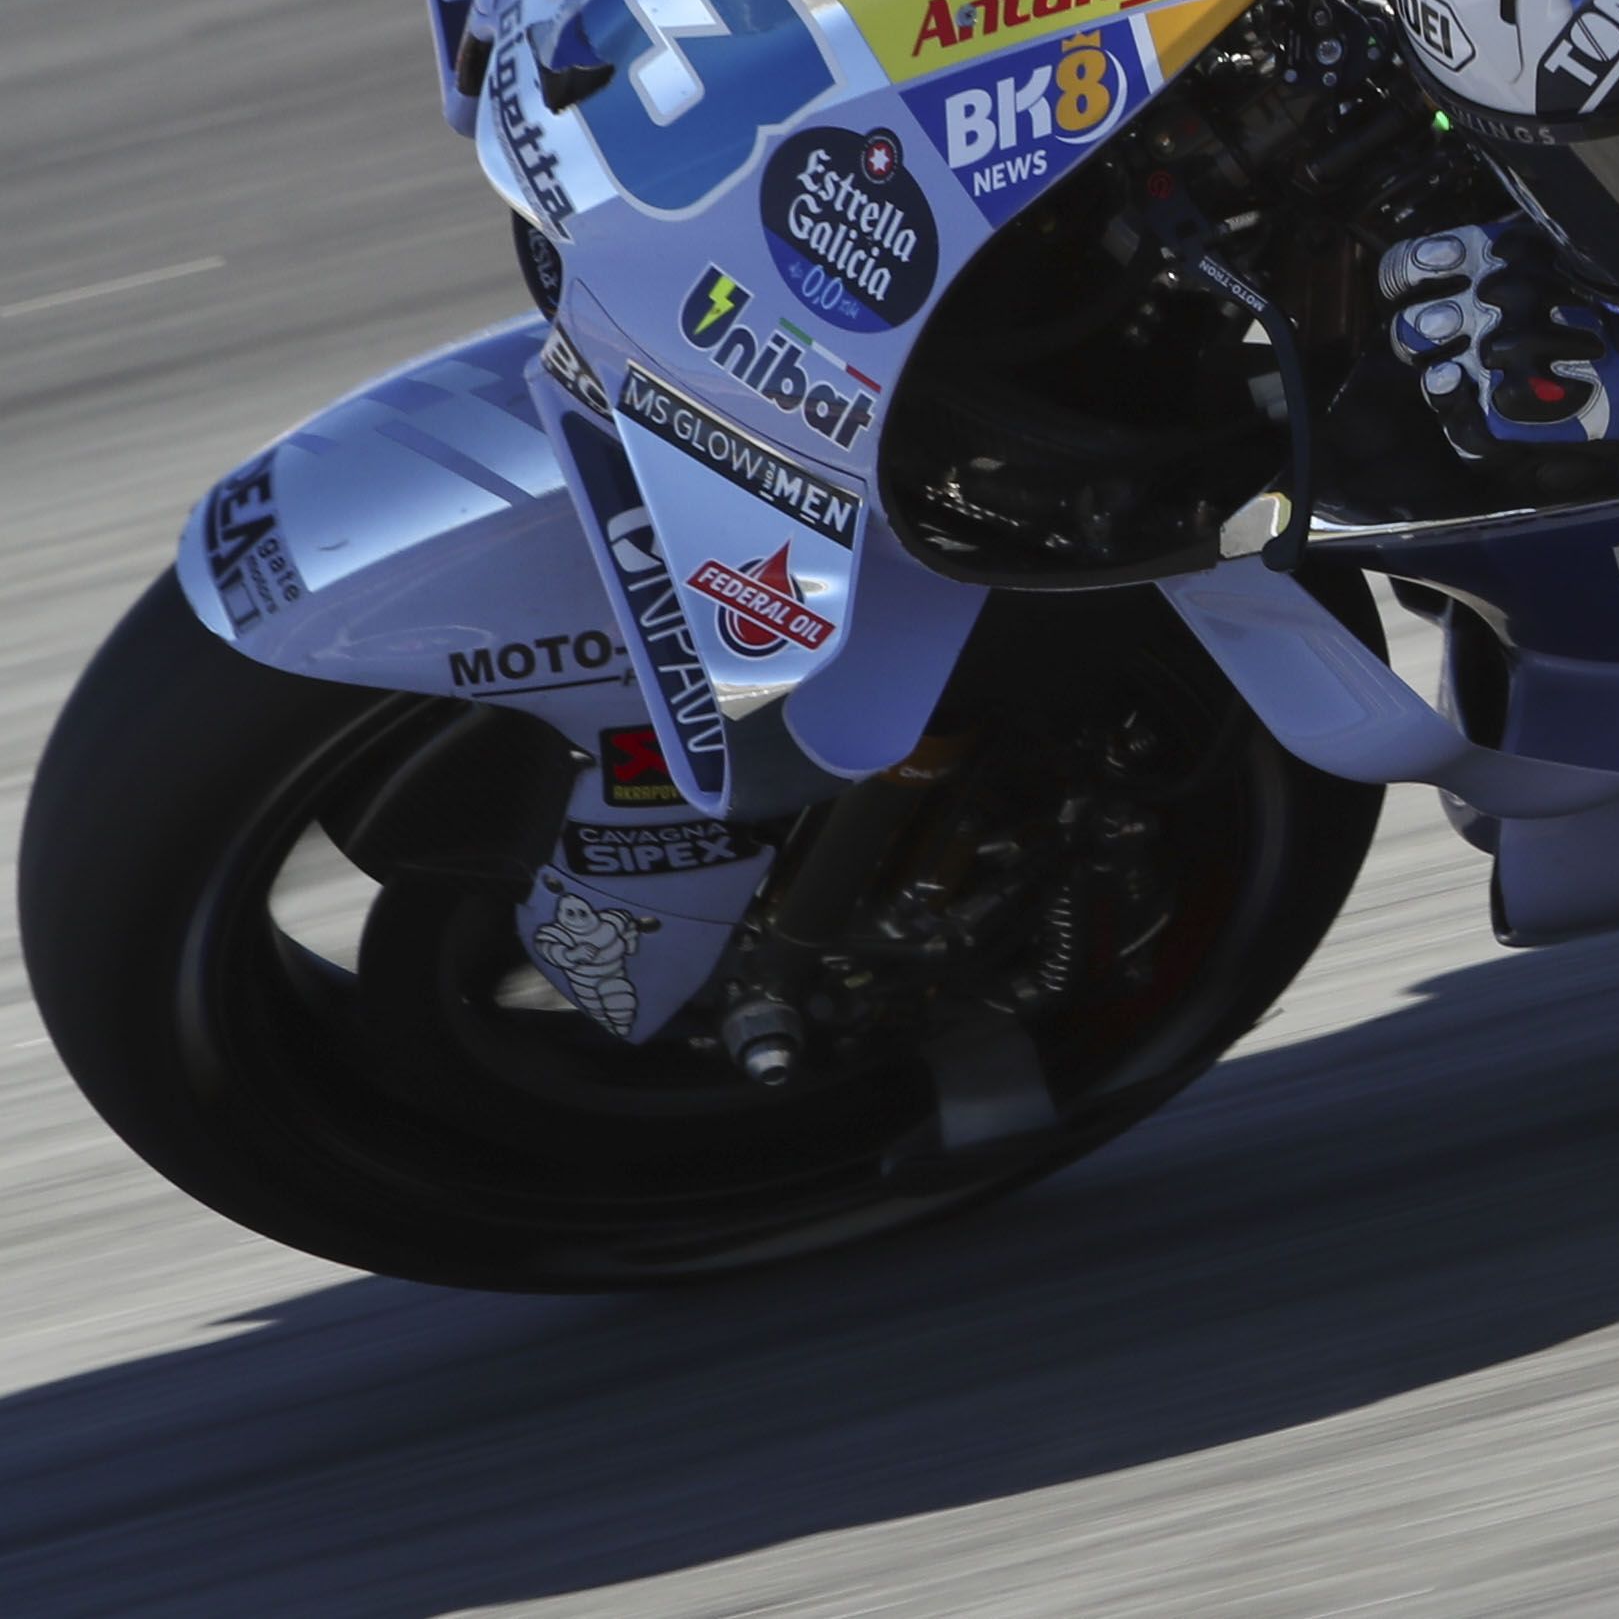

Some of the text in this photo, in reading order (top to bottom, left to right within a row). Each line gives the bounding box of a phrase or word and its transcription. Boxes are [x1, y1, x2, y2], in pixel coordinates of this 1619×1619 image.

[945, 42, 1116, 169] BK8
[796, 148, 918, 263] Estrella
[973, 150, 1049, 197] NEWS
[788, 193, 892, 301] Galicia
[680, 263, 876, 452] Unibat
[624, 371, 673, 425] MS
[673, 409, 764, 481] GLOW
[773, 467, 853, 533] MEN
[256, 536, 301, 603] gate
[698, 565, 826, 644] FEDERAL OIL
[578, 820, 729, 845] CAVAGNA
[582, 835, 737, 874] SIPEX
